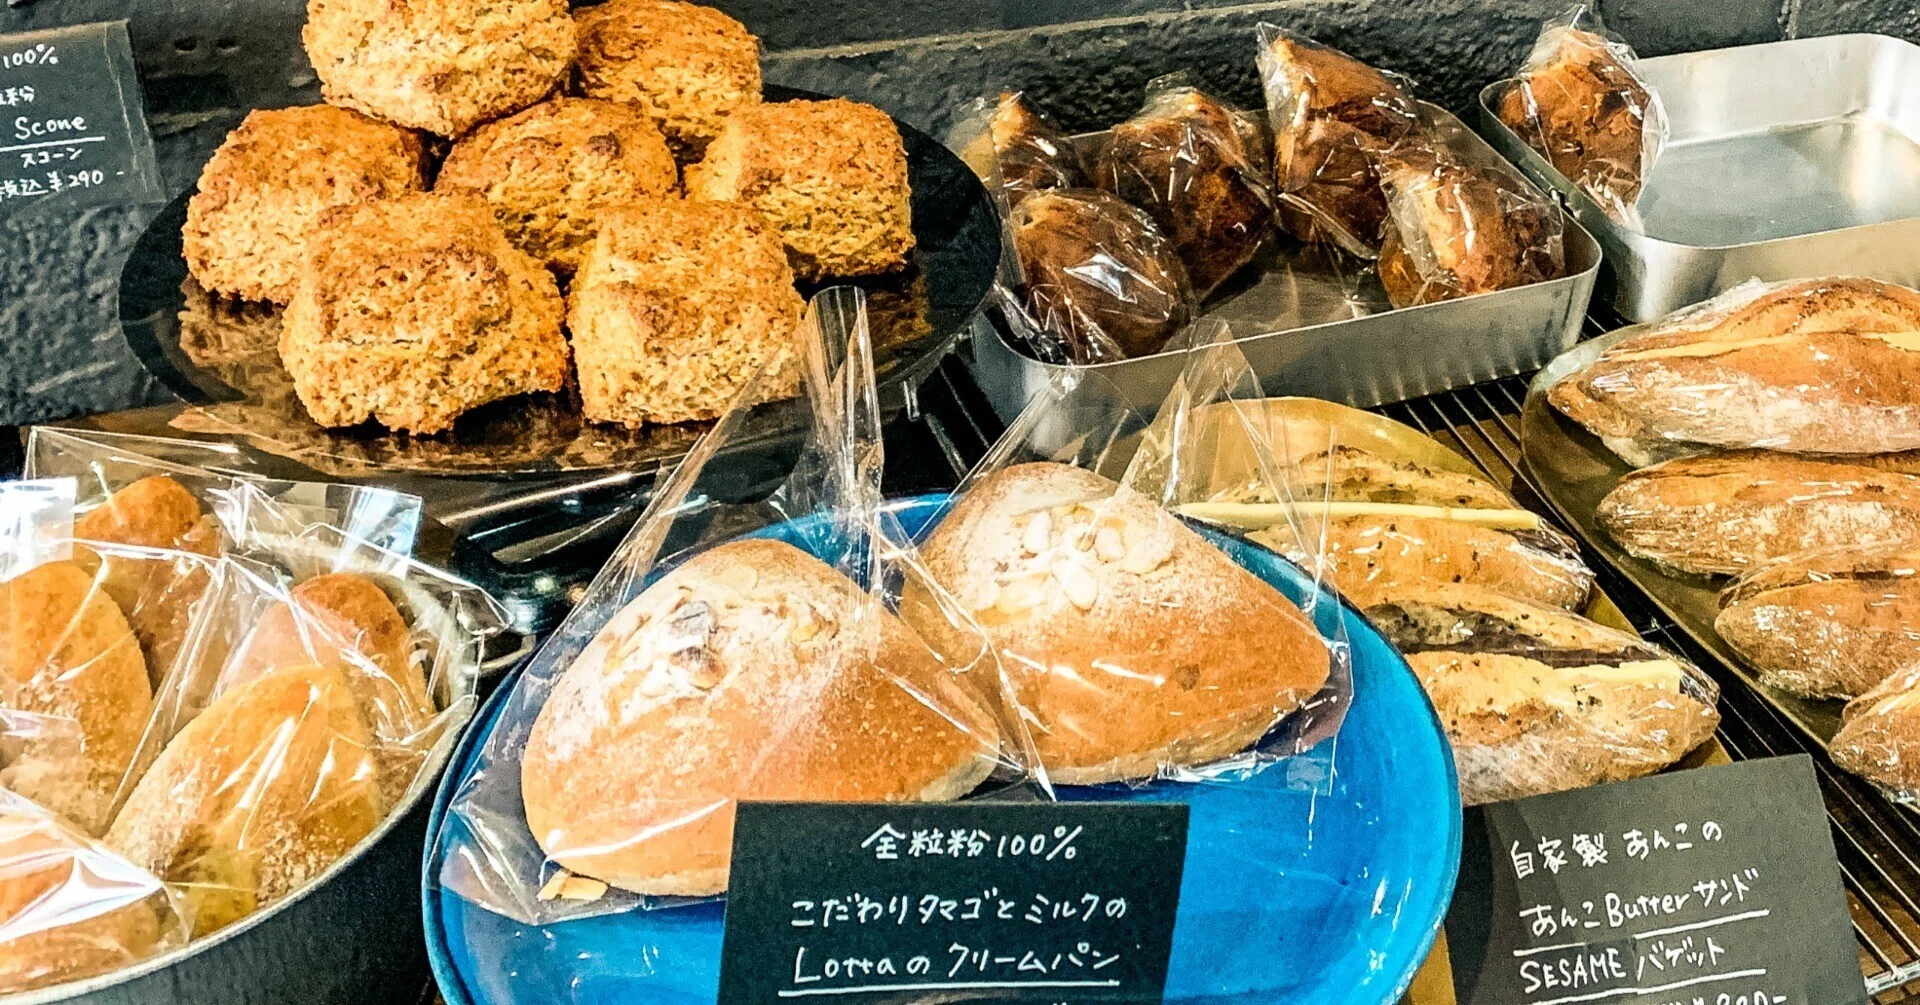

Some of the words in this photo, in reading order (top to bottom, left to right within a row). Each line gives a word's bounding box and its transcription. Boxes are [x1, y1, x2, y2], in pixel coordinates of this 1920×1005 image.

[14, 116, 87, 140] Scone
[20, 147, 83, 168] スコーン
